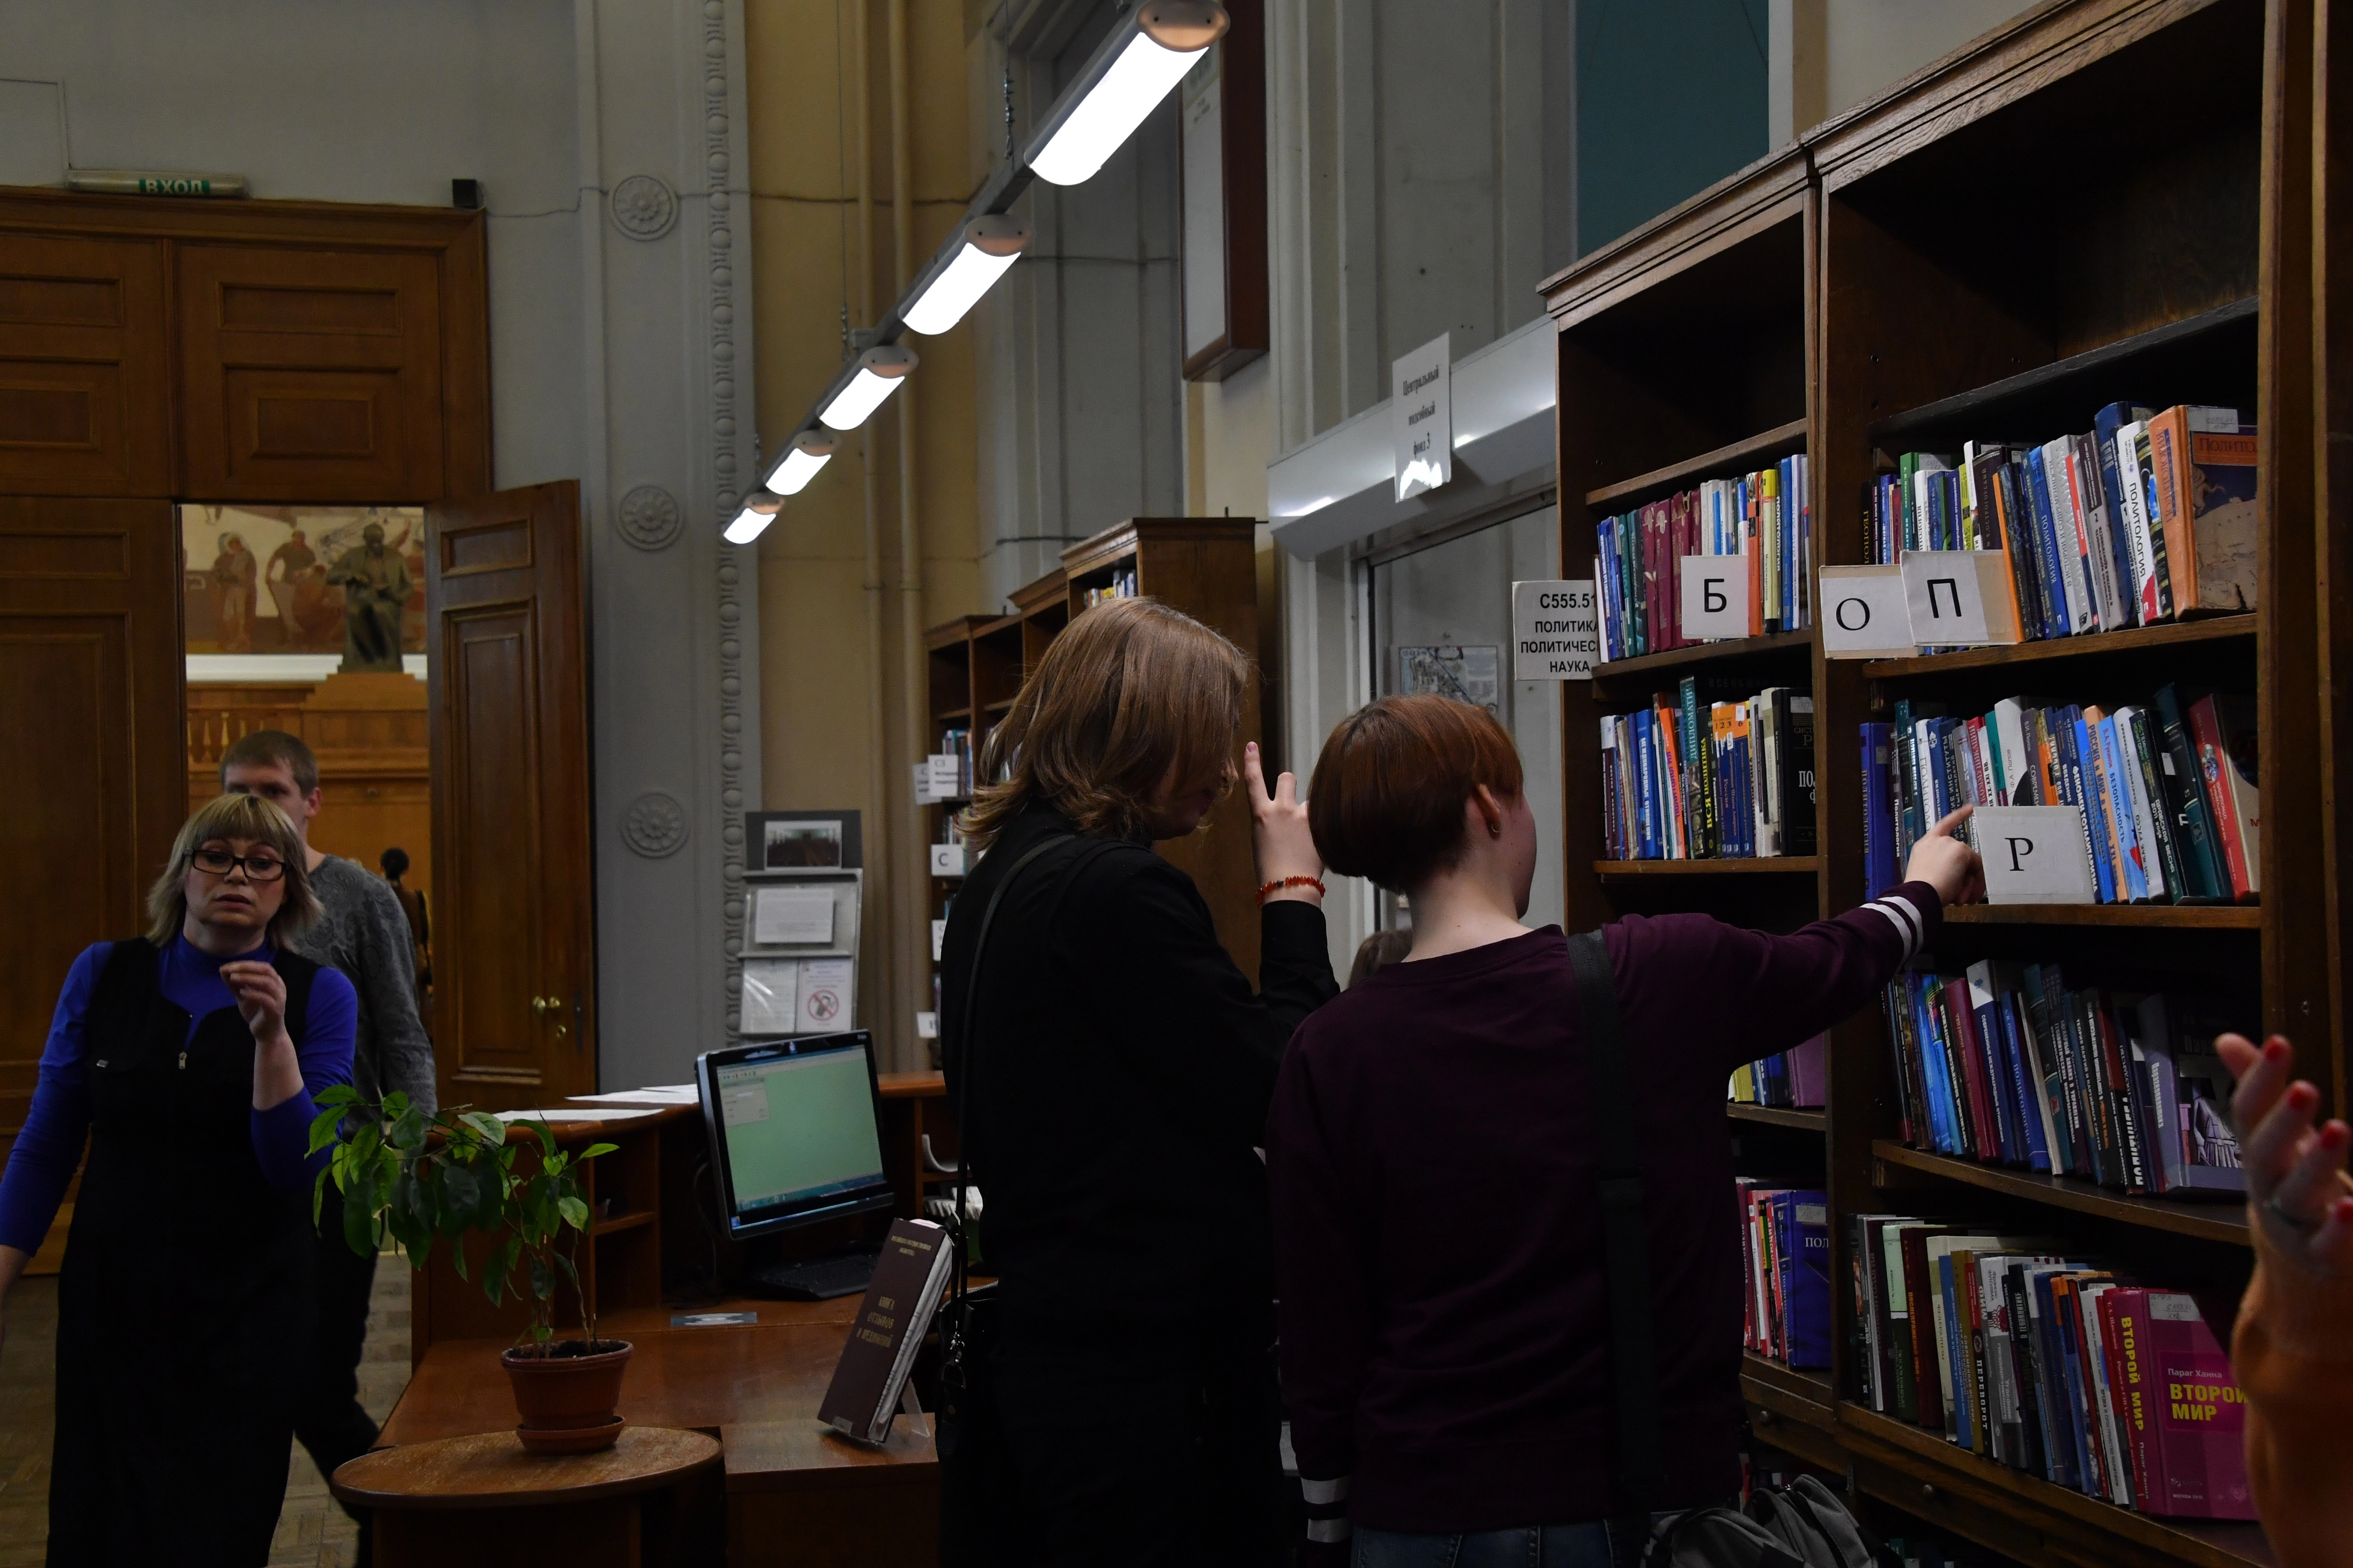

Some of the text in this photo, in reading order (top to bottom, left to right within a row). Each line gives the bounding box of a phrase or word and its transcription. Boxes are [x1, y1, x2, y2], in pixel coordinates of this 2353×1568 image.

[2049, 458, 2064, 530] СОВРЕМЕННОСТИ
[2041, 515, 2057, 583] ПОЛИТОЛОГИЯ
[2060, 540, 2071, 580] ИСТОРИИ
[2129, 482, 2146, 578] ПОЛИТОЛОГИЯ
[1704, 578, 1727, 613] Б
[1836, 598, 1870, 631] О
[1927, 579, 1962, 618] П
[1550, 661, 1590, 673] НАУКА
[1700, 737, 1713, 829] ВСЯ ПОЛИТИКА
[1798, 770, 1816, 787] ПО
[1942, 735, 1953, 793] ИНСТИТУТЫ
[1968, 725, 1986, 802] КОММУНИКАЦИИ
[2062, 763, 2072, 803] ВВЕДЕНИЕ
[2087, 724, 2101, 762] РОССИЯ
[2097, 773, 2107, 794] МИР
[1861, 770, 1869, 854] ПОЛИТОЛОГИЯ
[2072, 766, 2084, 812] ФЕНОМЕН
[2079, 812, 2098, 893] ТОТАЛИТАРИЗМА
[2110, 772, 2125, 843] БЕЗОПАСНОСТЬ
[2004, 837, 2034, 872] Р
[1981, 1014, 2004, 1143] СОВРЕМЕННЫЕ МЕЖДУНАРОДНЫЕ ОТНОШЕНИЯ
[2013, 1063, 2031, 1144] ПОЛИТОЛОГИЯ
[2080, 1045, 2088, 1072] ПАРТИЙ
[2086, 1079, 2096, 1121] ПАРТИЙНЫХ
[2093, 1122, 2101, 1151] СИСТЕМ
[2119, 1044, 2131, 1095] ГОСУДАРСТВО
[1976, 1359, 1988, 1430] ПЕРЕВОРОТ
[2120, 1316, 2141, 1384] ВТОРОЙ
[2131, 1391, 2144, 1431] МИР
[2167, 1368, 2222, 1379] Параг Ханна
[2171, 1403, 2217, 1421] МИР
